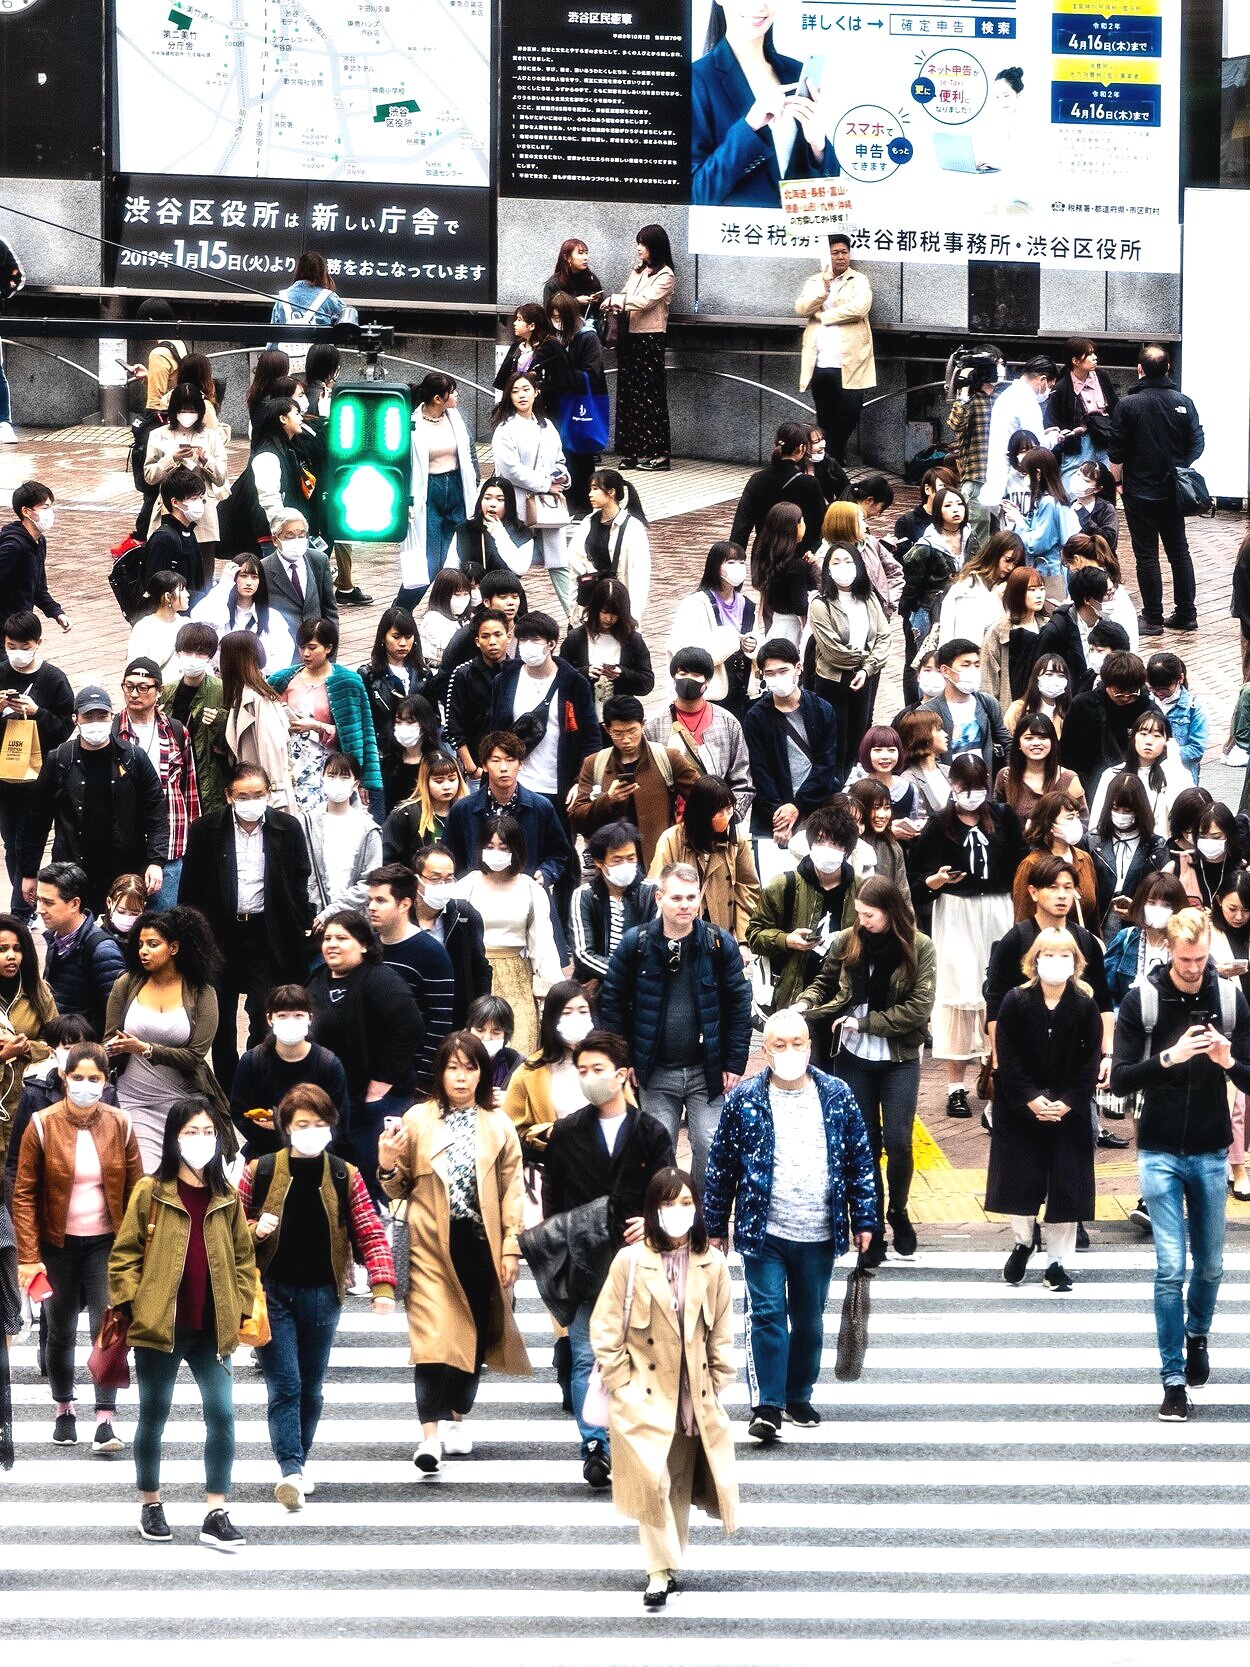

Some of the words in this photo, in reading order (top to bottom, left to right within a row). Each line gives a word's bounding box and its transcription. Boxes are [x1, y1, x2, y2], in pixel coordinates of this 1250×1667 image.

[801, 14, 862, 31] 詳しくは
[901, 19, 964, 33] 確定申告
[981, 20, 1011, 35] 検索
[1092, 22, 1121, 30] 令和2年
[163, 30, 197, 39] 第二美竹
[167, 41, 194, 50] 分庁舎
[1068, 33, 1148, 52] 4月16日(木)まで
[915, 84, 931, 95] 更に
[1092, 90, 1120, 98] 令和2年
[390, 107, 408, 117] 渋谷
[1070, 102, 1150, 121] 4月16日(木)まで
[386, 118, 412, 128] 区役所
[855, 143, 884, 159] 申告
[892, 147, 909, 155] もっと
[121, 239, 486, 281] 2019年1月15日(火)より務をおこなっています
[8, 740, 23, 748] LUSH
